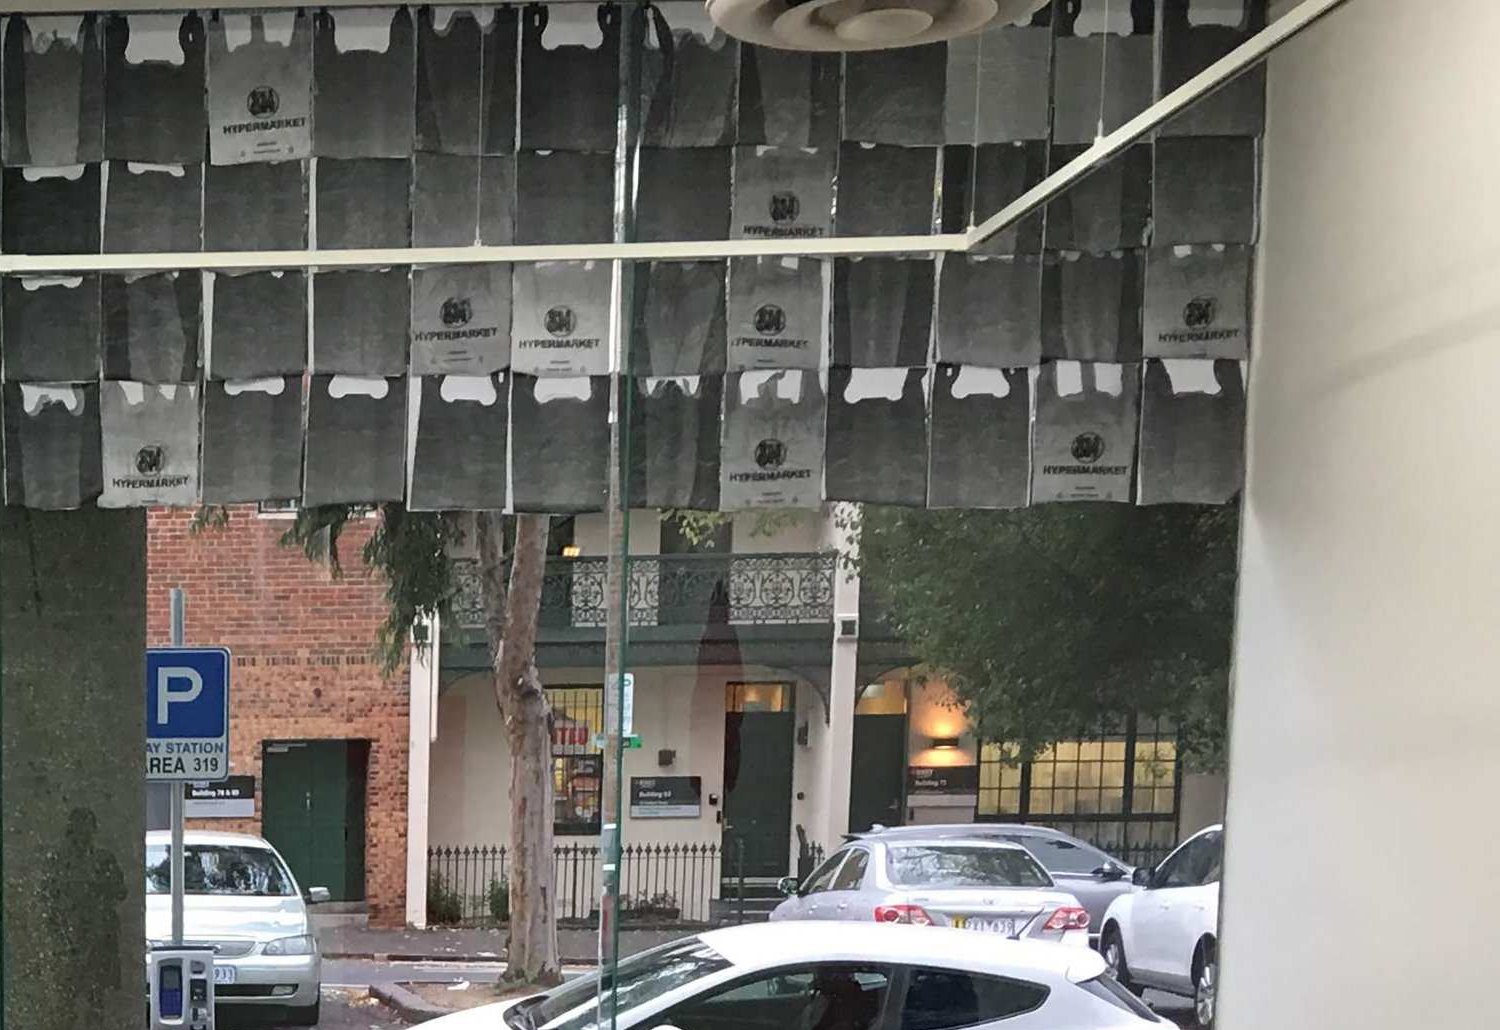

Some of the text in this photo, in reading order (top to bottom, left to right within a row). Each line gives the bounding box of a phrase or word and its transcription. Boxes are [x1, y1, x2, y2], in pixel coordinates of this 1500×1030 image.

[223, 117, 305, 134] HYPERMARKET
[415, 327, 498, 341] HYPERMARKET
[1158, 329, 1240, 342] HYPERMARKET
[518, 338, 600, 349] HYPERMARKET
[729, 469, 811, 482] HYPERMARKET
[1043, 465, 1128, 475] HYPERMARKET
[112, 476, 188, 488] HYPERMARKET
[157, 666, 203, 725] P
[146, 742, 224, 754] AY STATION
[145, 757, 219, 774] REA 319
